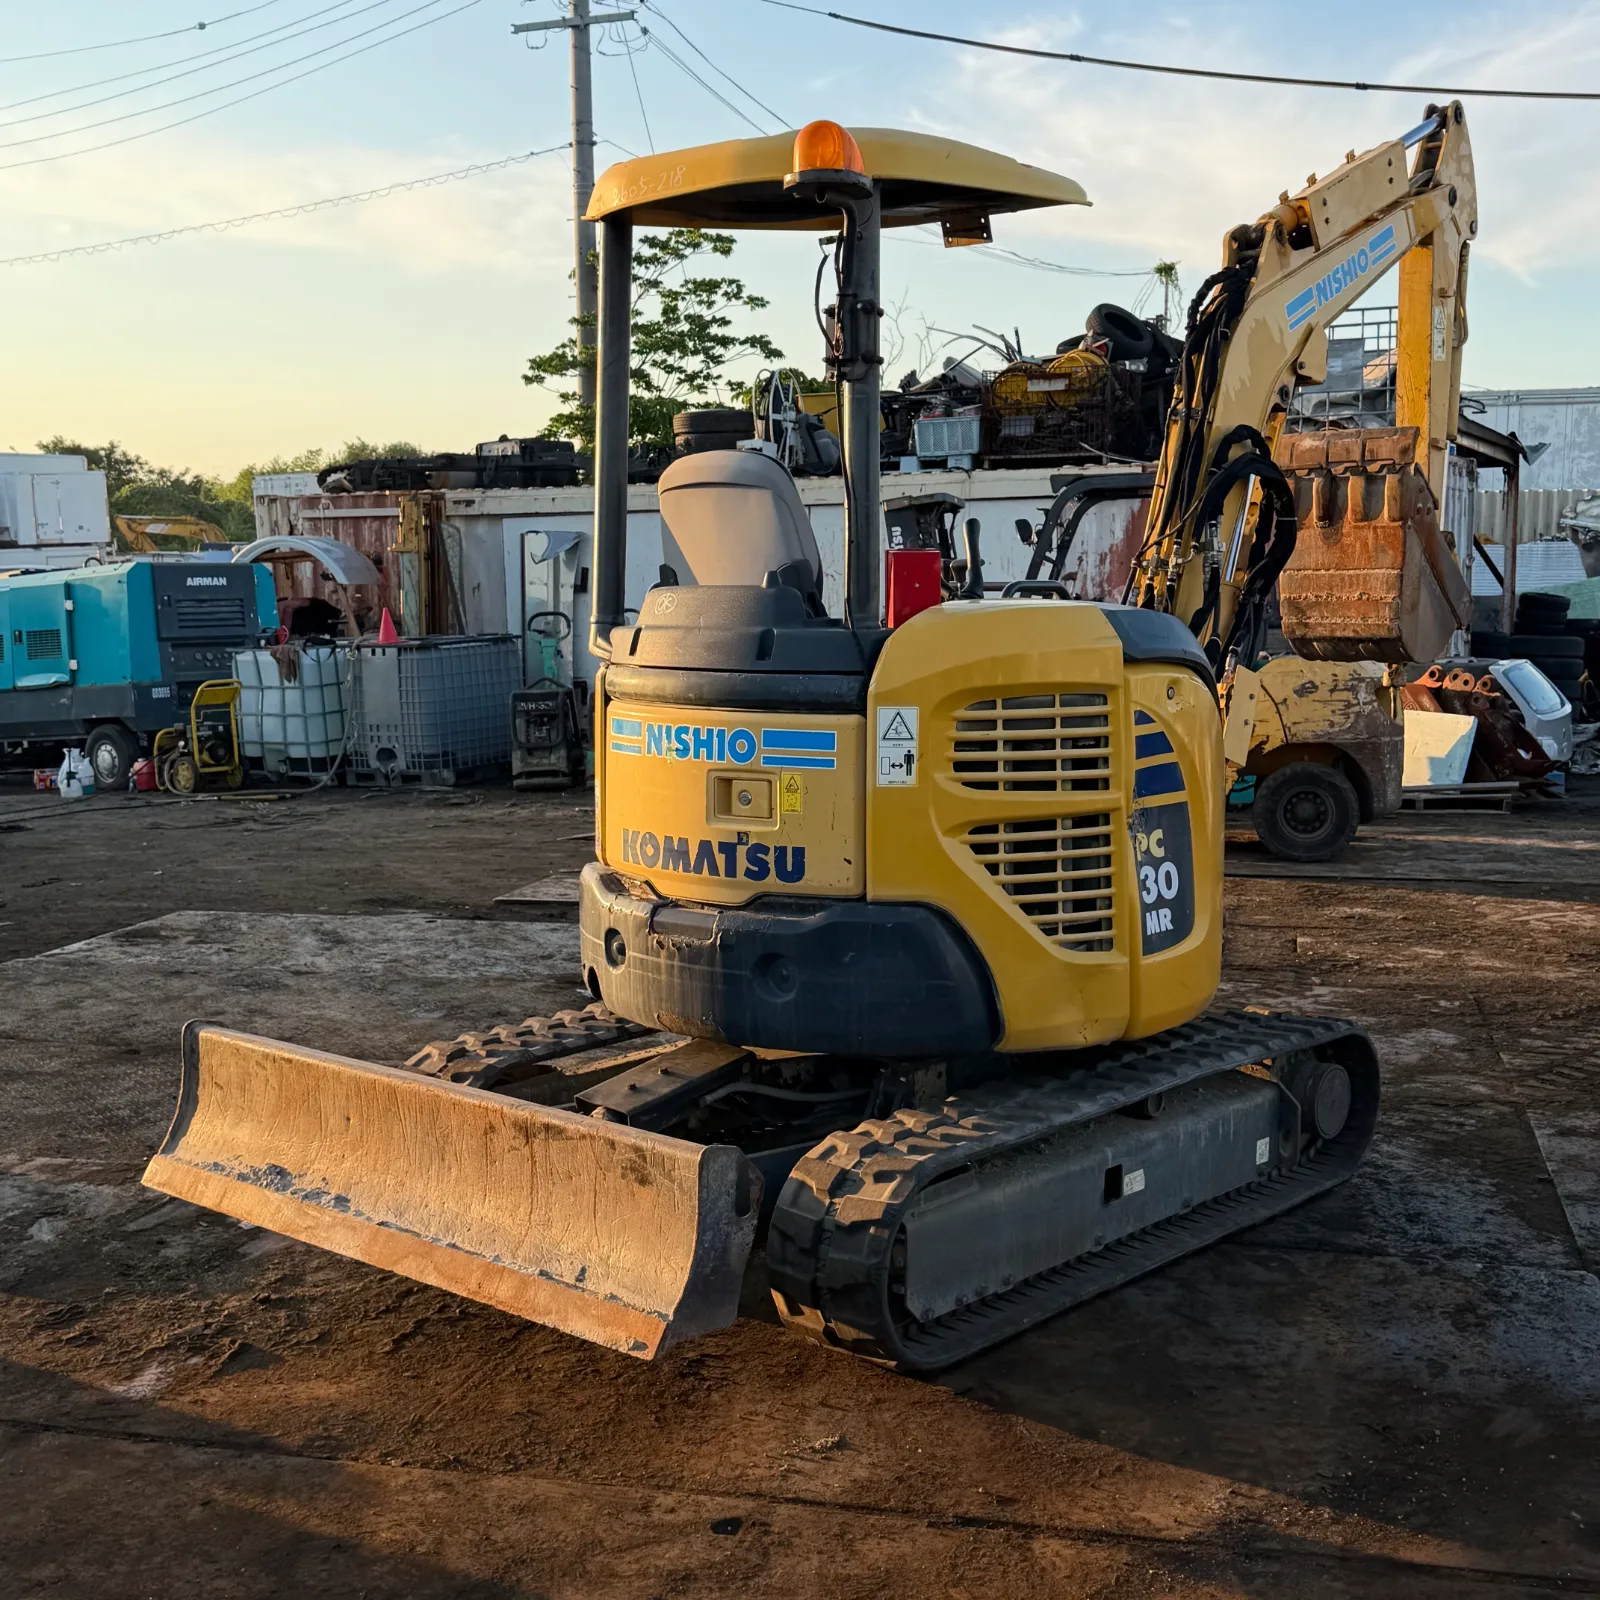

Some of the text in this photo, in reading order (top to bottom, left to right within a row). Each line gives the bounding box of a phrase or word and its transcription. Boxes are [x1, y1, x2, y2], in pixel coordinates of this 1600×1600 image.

[1315, 247, 1369, 308] NISHIO
[186, 576, 227, 586] AIRMAN
[645, 722, 757, 765] NISHIO
[622, 828, 806, 883] KOMATSU
[1135, 828, 1165, 861] PC
[1139, 861, 1179, 904] 30
[1145, 907, 1174, 936] MR
